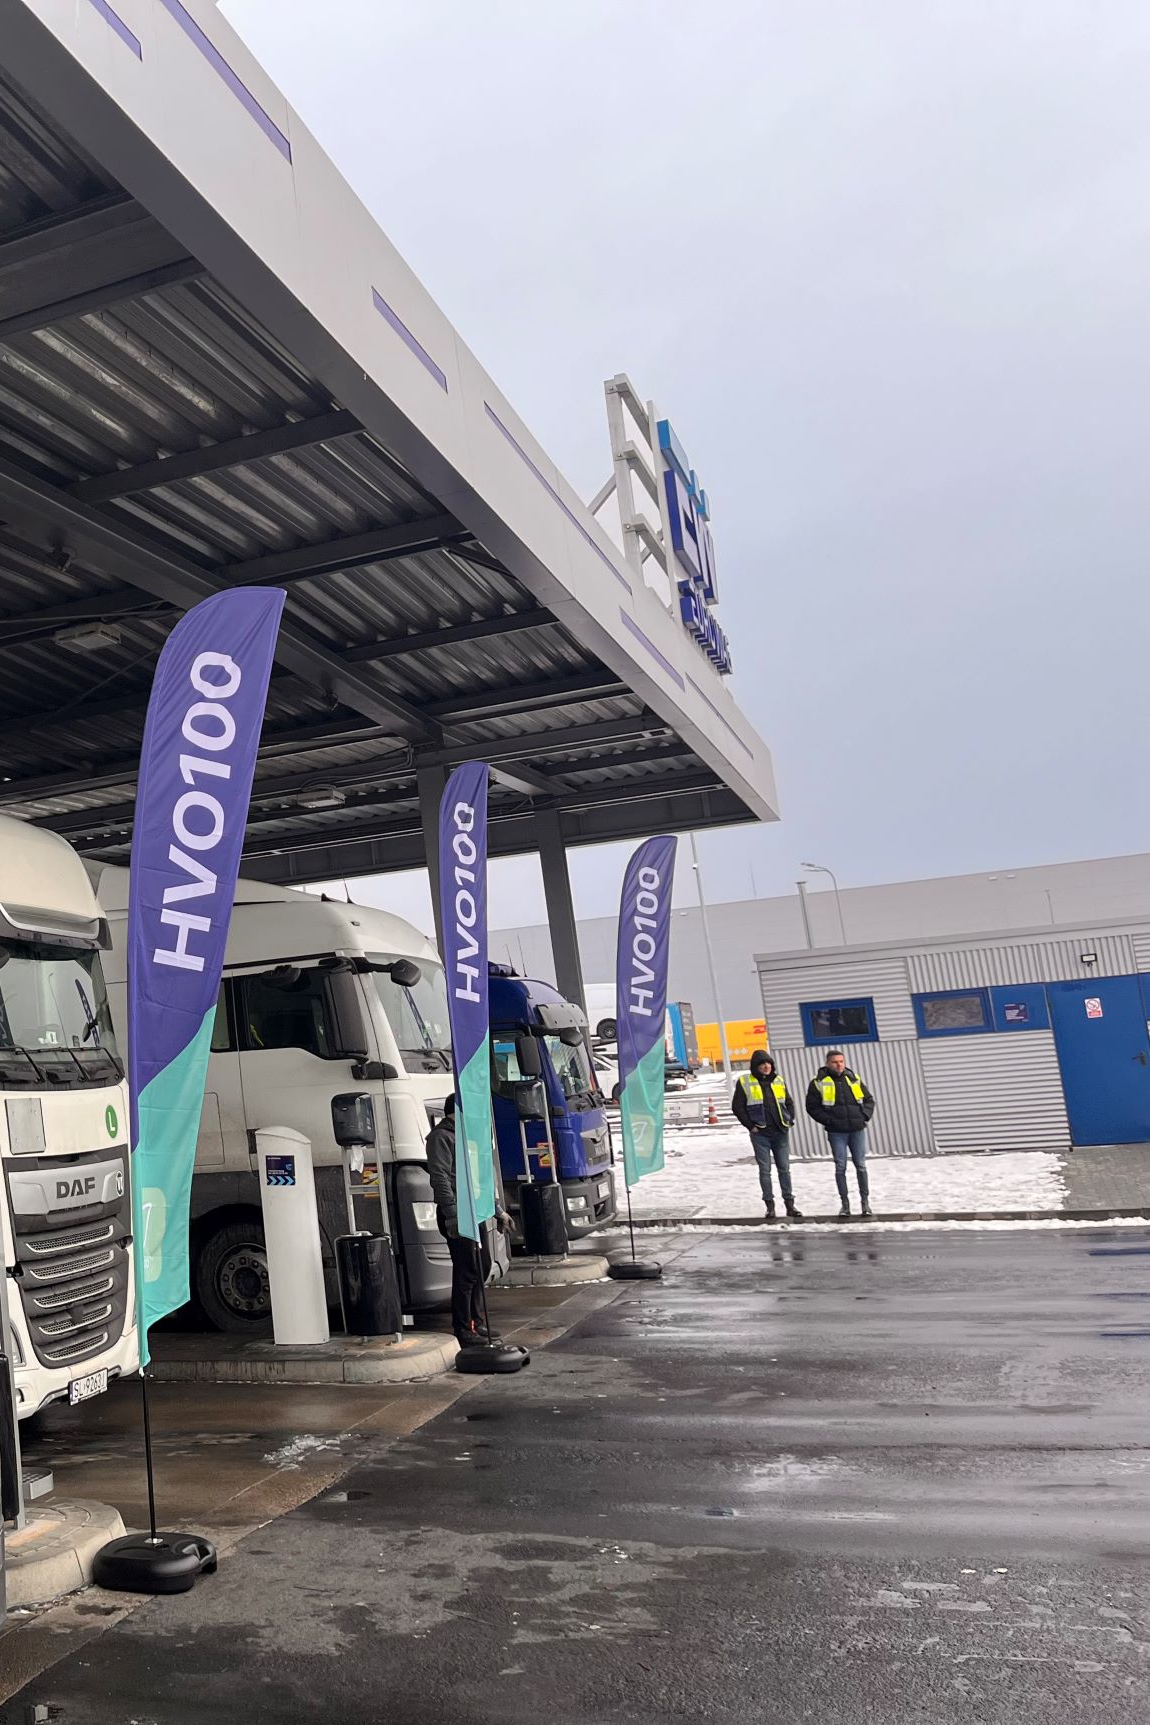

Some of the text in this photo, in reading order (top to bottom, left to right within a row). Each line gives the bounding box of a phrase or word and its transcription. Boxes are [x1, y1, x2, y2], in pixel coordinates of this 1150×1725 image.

[153, 652, 241, 972] HVO100
[453, 801, 481, 1003] HVO100
[629, 866, 660, 1017] HVO100
[56, 1177, 96, 1199] DAF
[108, 1111, 115, 1131] L
